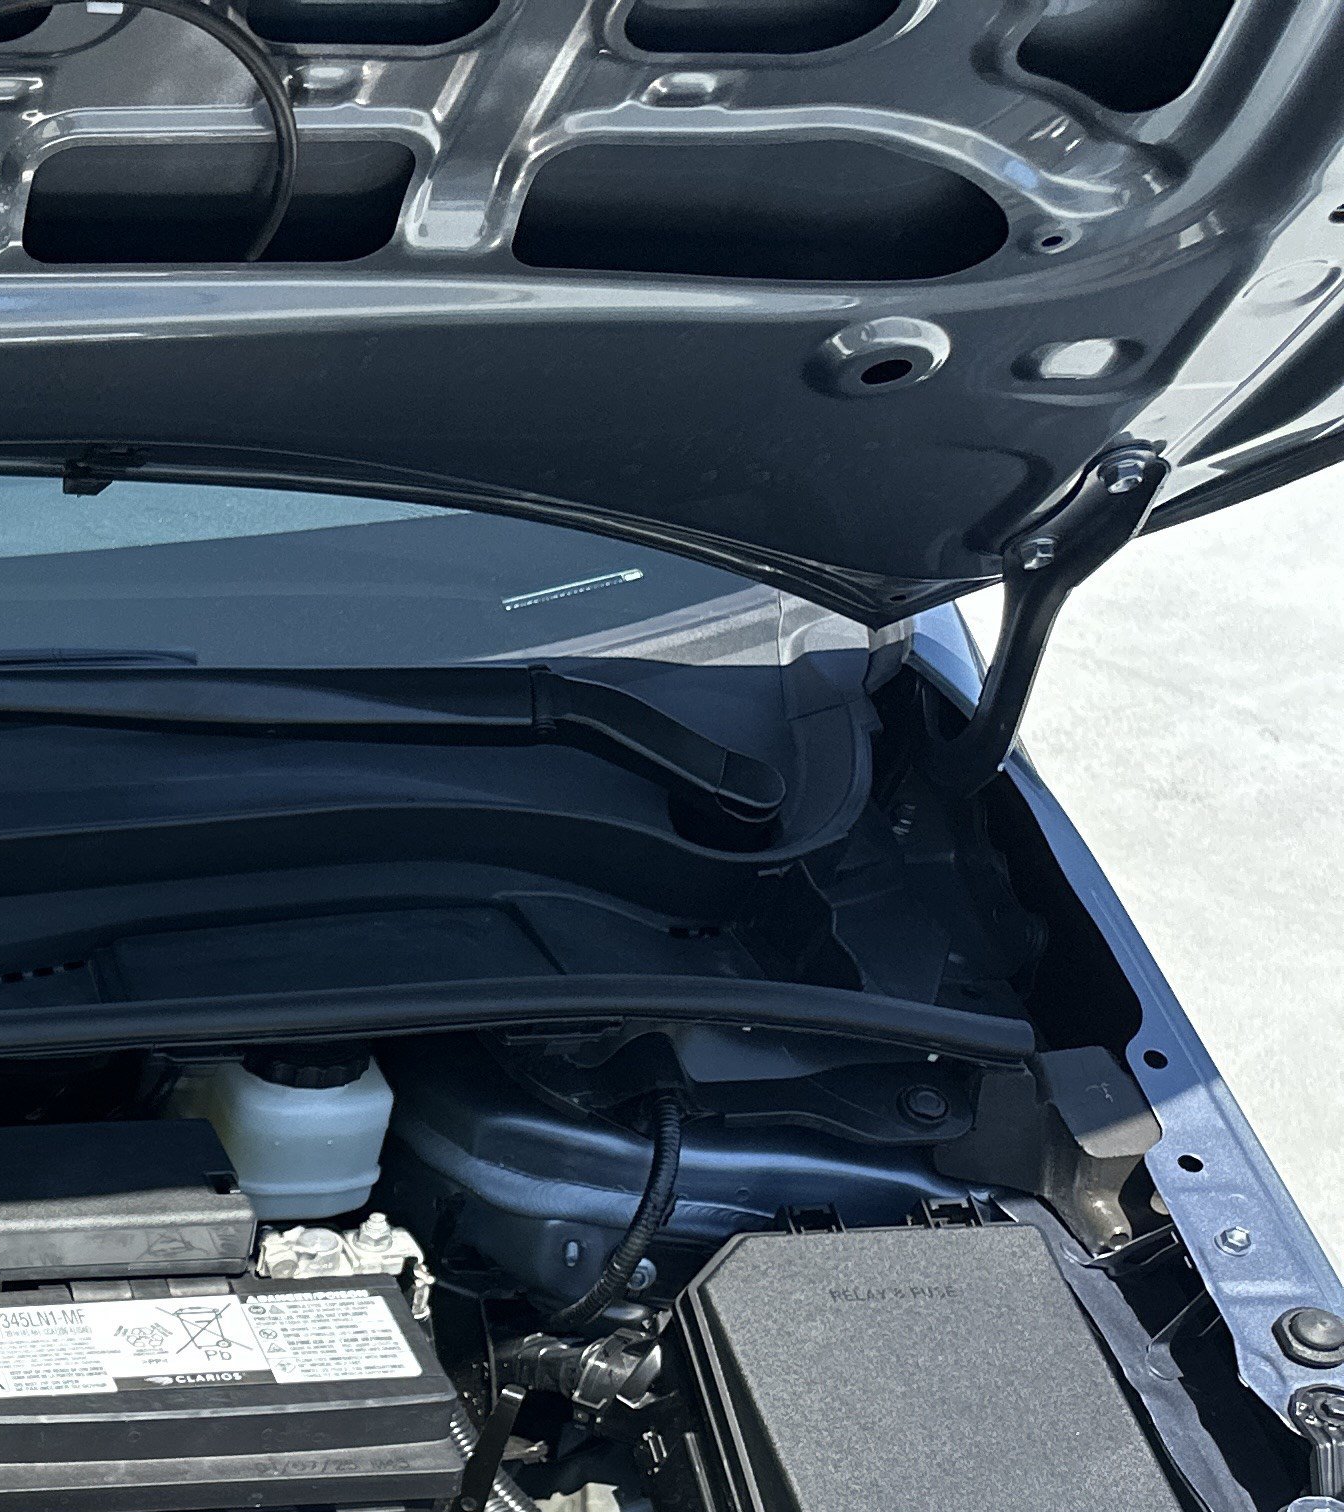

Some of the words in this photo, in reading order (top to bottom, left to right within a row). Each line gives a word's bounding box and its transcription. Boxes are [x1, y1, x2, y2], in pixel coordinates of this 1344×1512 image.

[828, 1286, 886, 1302] RELAY
[909, 1285, 959, 1299] FUSE
[0, 1308, 86, 1329] 345LN1-MF
[204, 1349, 232, 1361] Pb
[175, 1372, 243, 1384] CLARIOS
